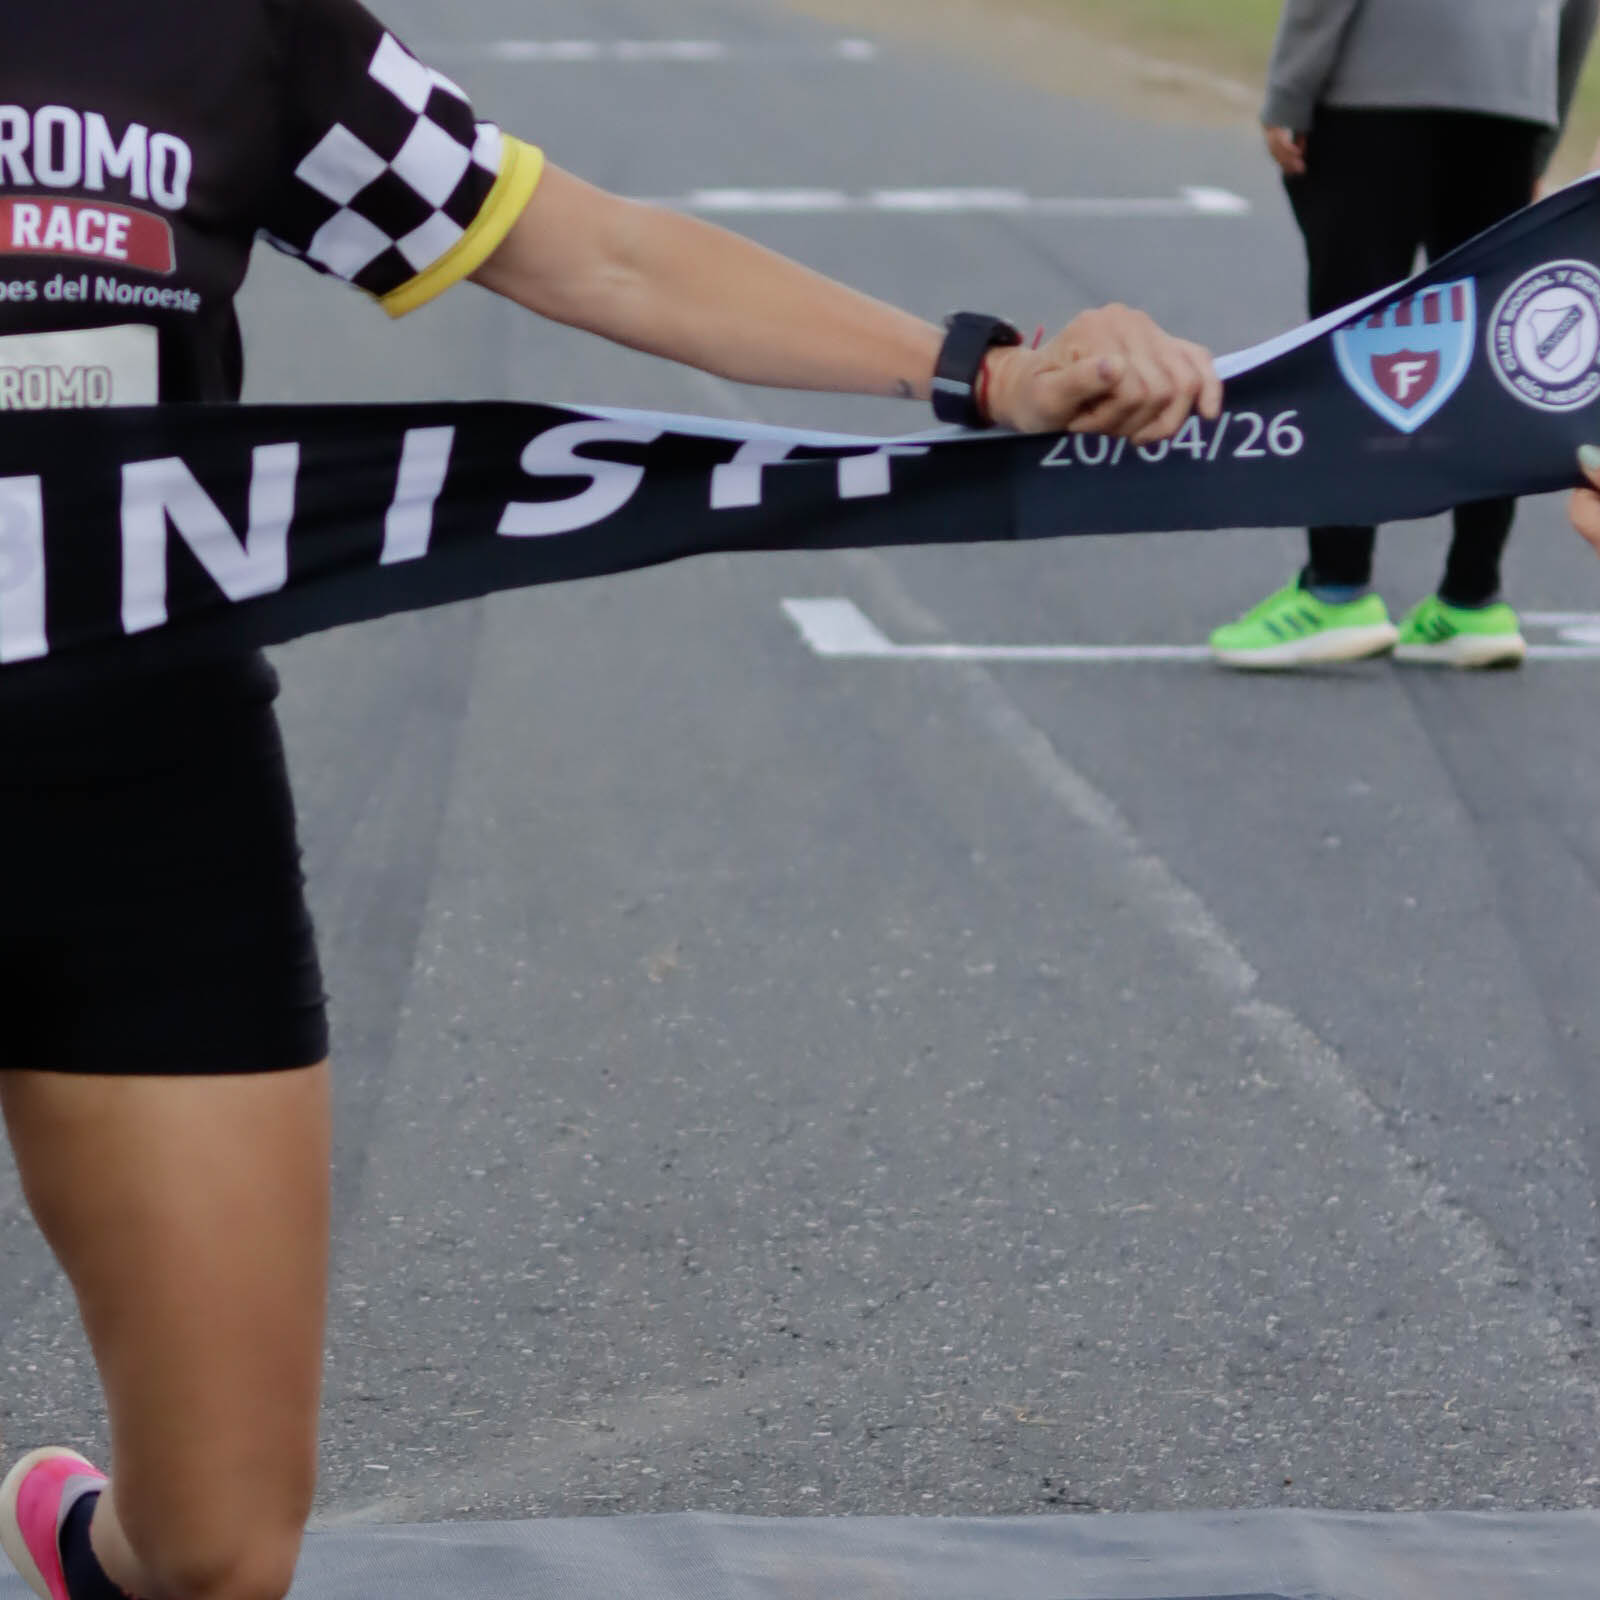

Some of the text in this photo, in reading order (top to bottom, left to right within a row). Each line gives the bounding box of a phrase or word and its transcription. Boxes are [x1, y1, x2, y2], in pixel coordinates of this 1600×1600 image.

[11, 203, 132, 260] RACE
[43, 274, 88, 300] del
[95, 277, 201, 313] Noroeste
